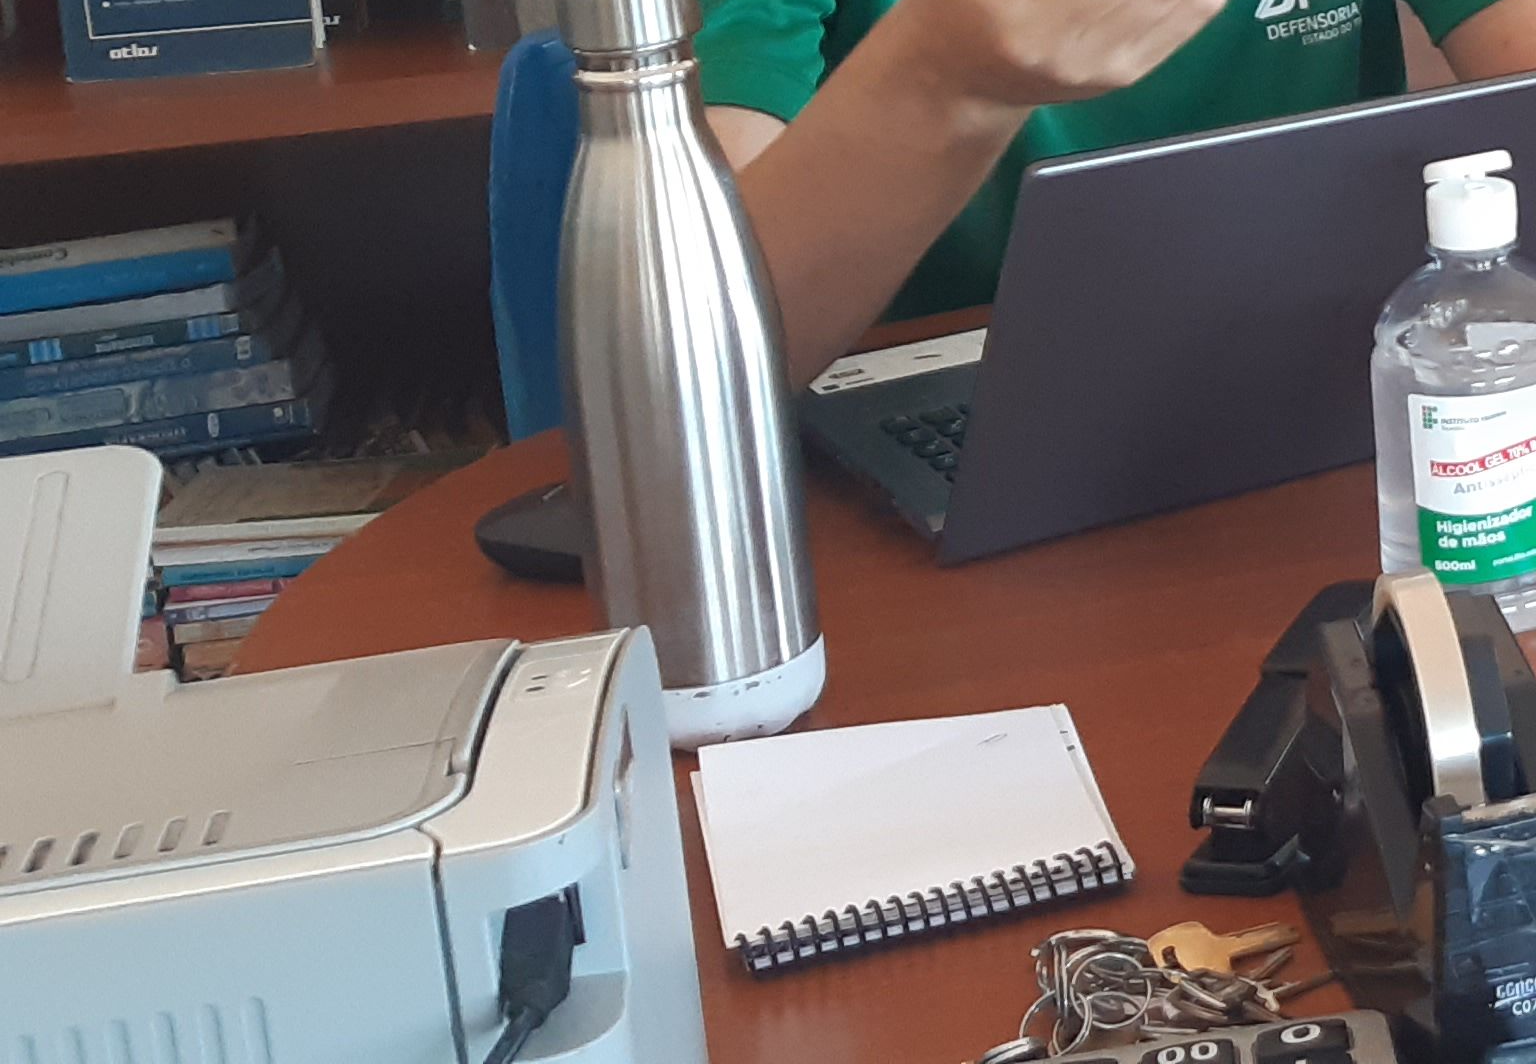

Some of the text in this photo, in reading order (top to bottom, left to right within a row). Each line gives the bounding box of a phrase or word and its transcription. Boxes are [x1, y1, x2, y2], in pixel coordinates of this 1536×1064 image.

[1266, 2, 1361, 40] DEFENSORIA
[1485, 452, 1508, 468] GEL
[1436, 505, 1534, 535] Higienizador
[1438, 530, 1506, 548] de mãos
[1434, 559, 1477, 571] 500ml
